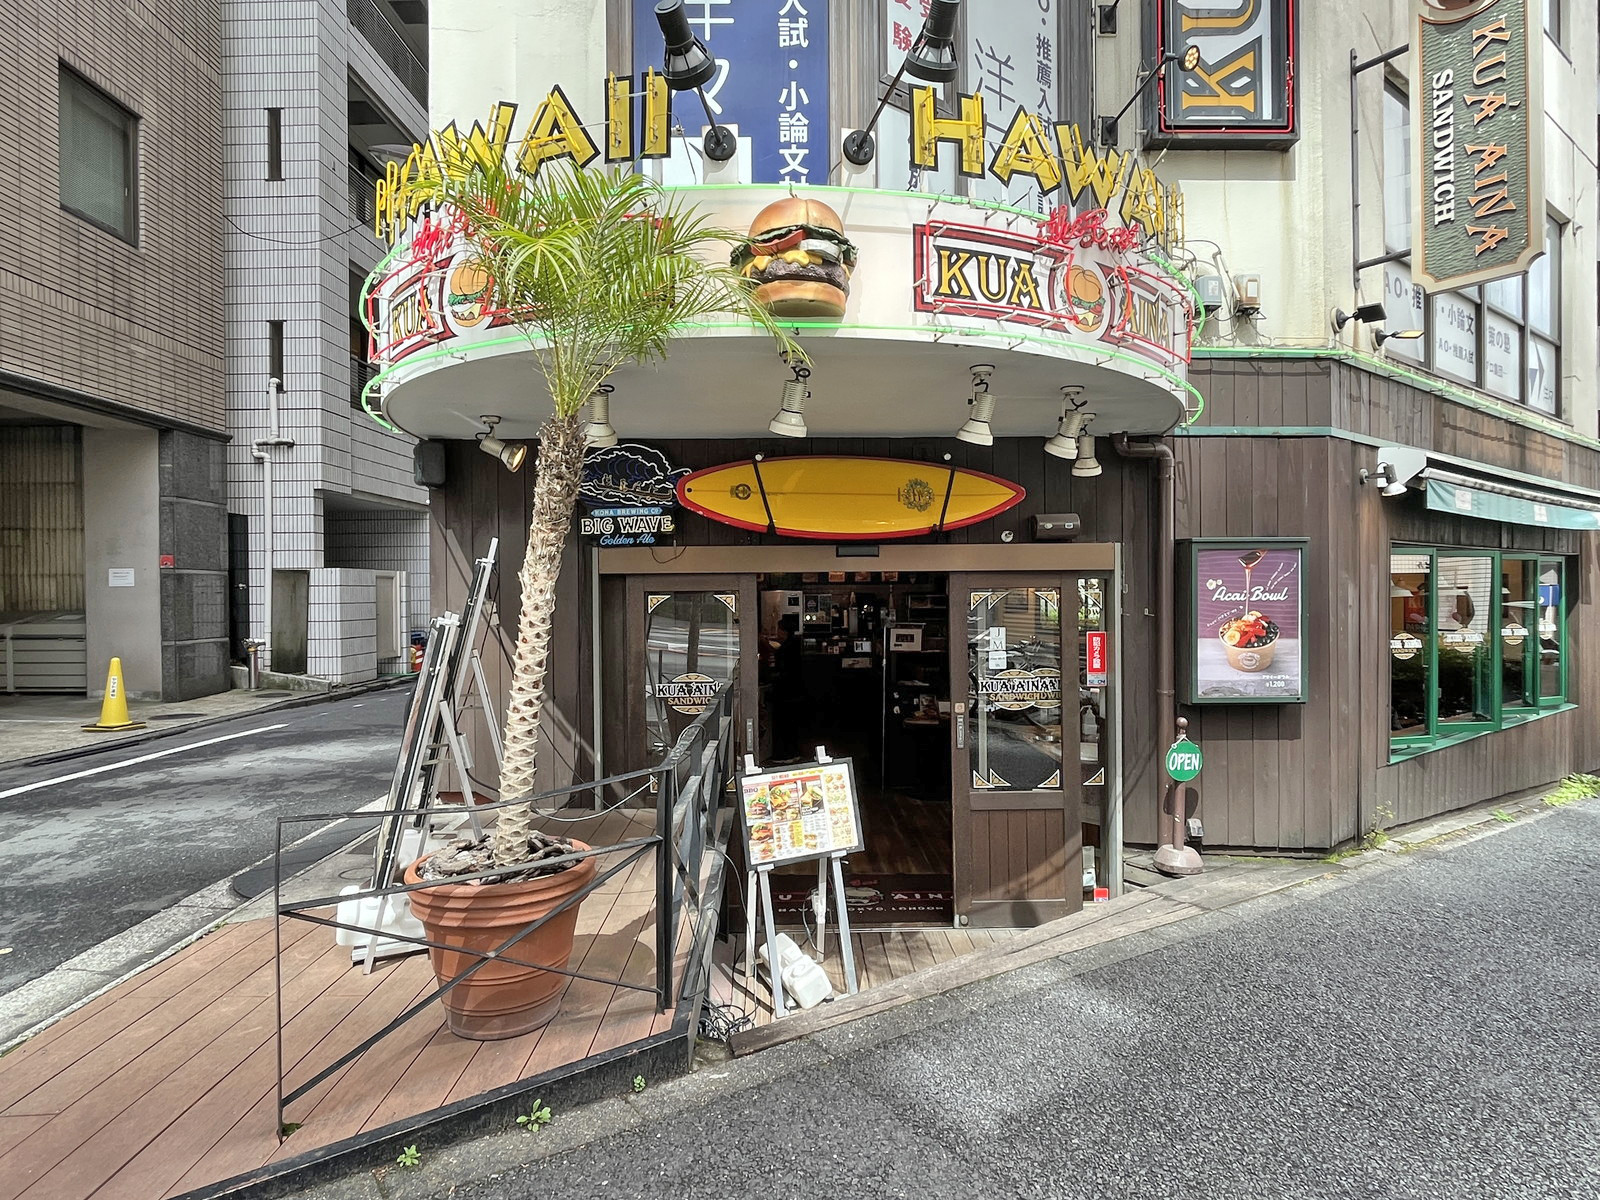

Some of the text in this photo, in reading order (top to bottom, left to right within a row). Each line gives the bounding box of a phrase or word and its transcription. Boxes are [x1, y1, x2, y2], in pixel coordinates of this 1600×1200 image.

[1432, 67, 1456, 226] SANDWICH
[932, 246, 1044, 311] KUA
[391, 286, 437, 345] KUA
[580, 515, 675, 534] BIG WAVE
[600, 533, 655, 545] Golden Ale
[1211, 586, 1288, 602] Acai Bowl
[657, 684, 687, 696] KUA
[980, 681, 1010, 693] KUA
[1168, 752, 1200, 771] OPEN
